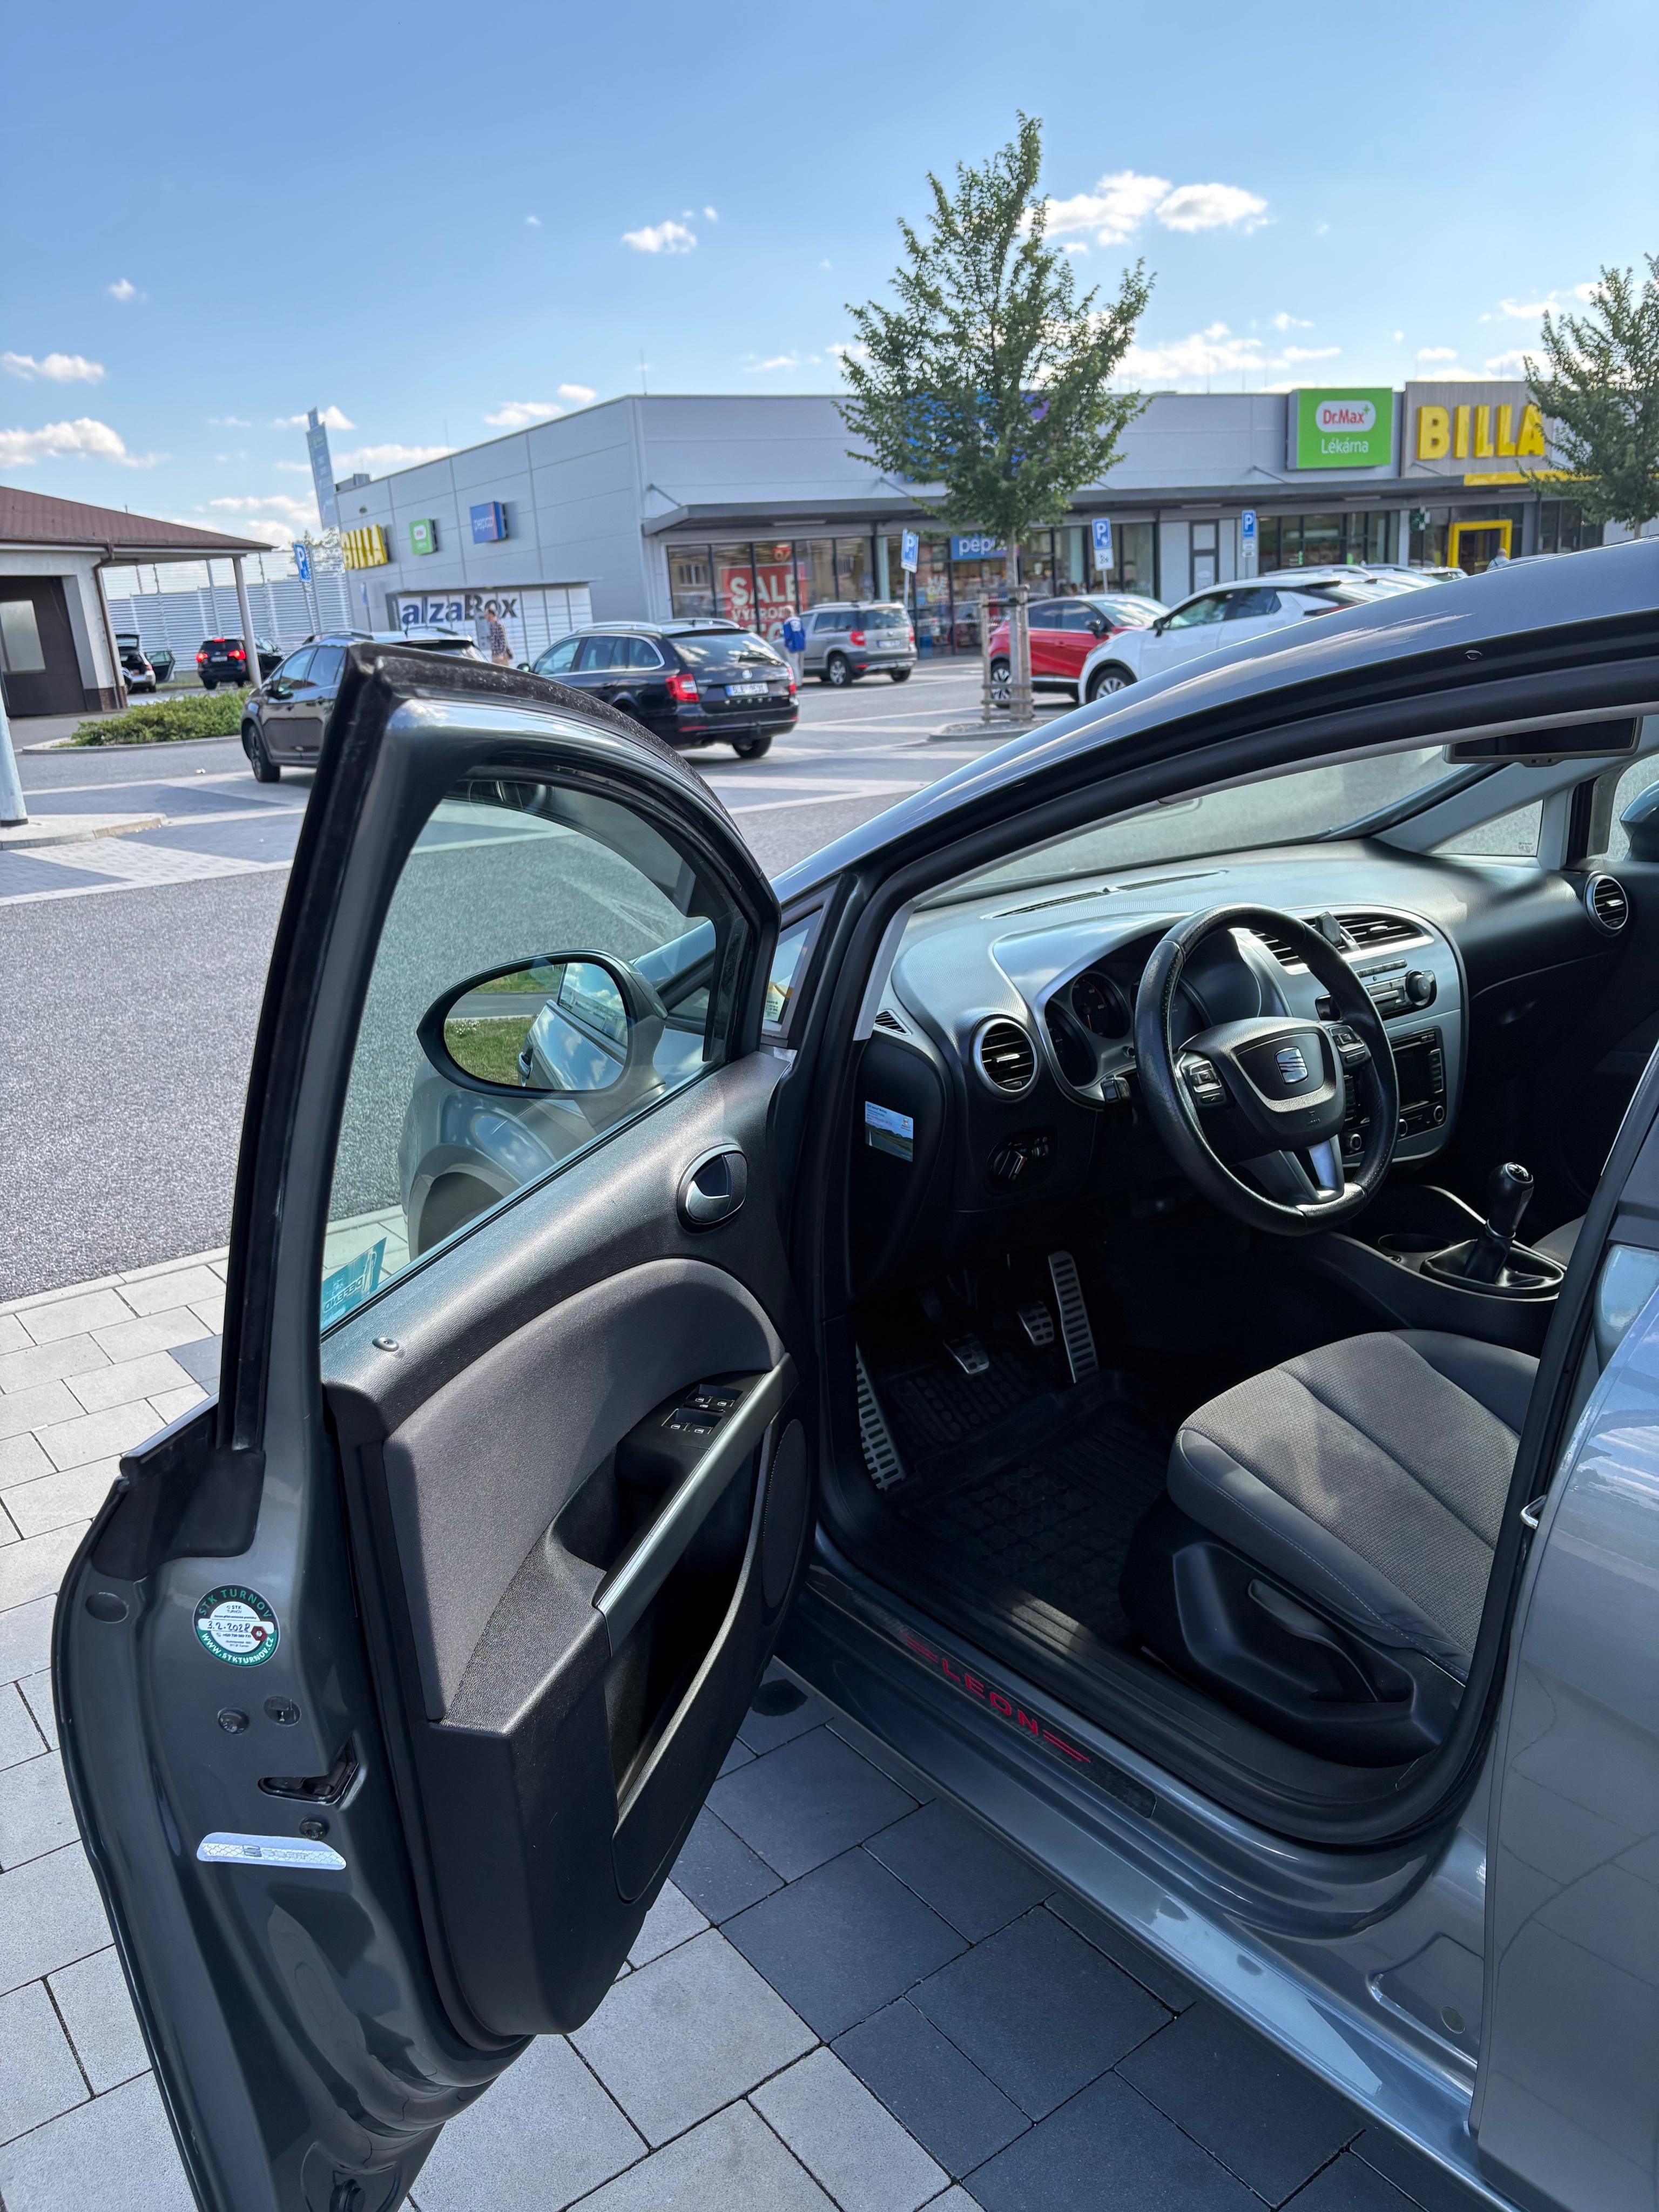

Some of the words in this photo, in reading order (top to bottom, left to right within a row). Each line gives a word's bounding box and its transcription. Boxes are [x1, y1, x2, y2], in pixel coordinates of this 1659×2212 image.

[1321, 437, 1369, 454] Lékárna
[1417, 404, 1545, 460] BILLA
[1096, 522, 1107, 540] P
[198, 1594, 218, 1615] STK
[220, 1589, 272, 1617] TURNOV
[941, 1658, 1038, 1736] LEON
